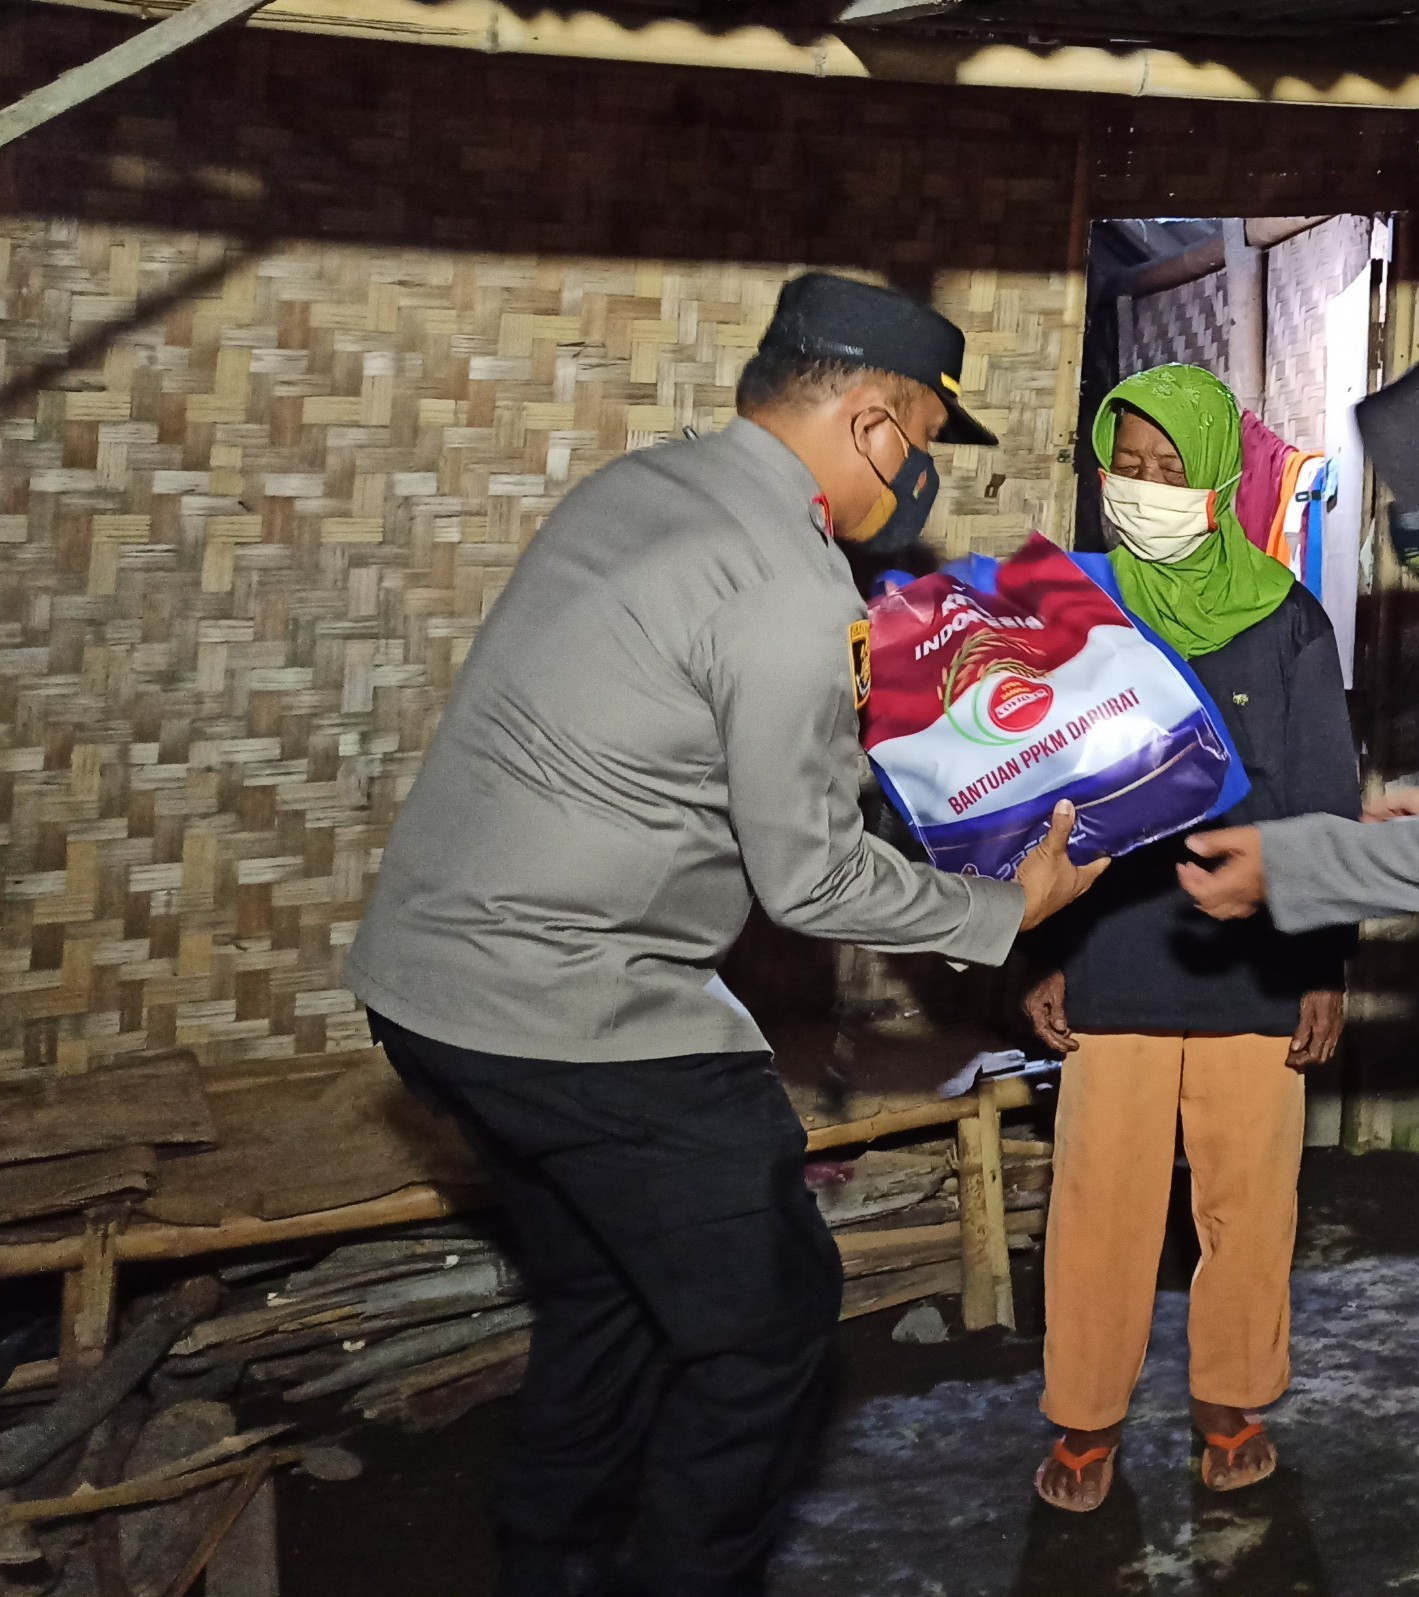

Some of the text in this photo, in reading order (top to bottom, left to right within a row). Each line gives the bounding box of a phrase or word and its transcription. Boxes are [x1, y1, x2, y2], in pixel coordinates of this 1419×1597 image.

[947, 686, 1141, 816] BANTUAN PPKM DARURAT
